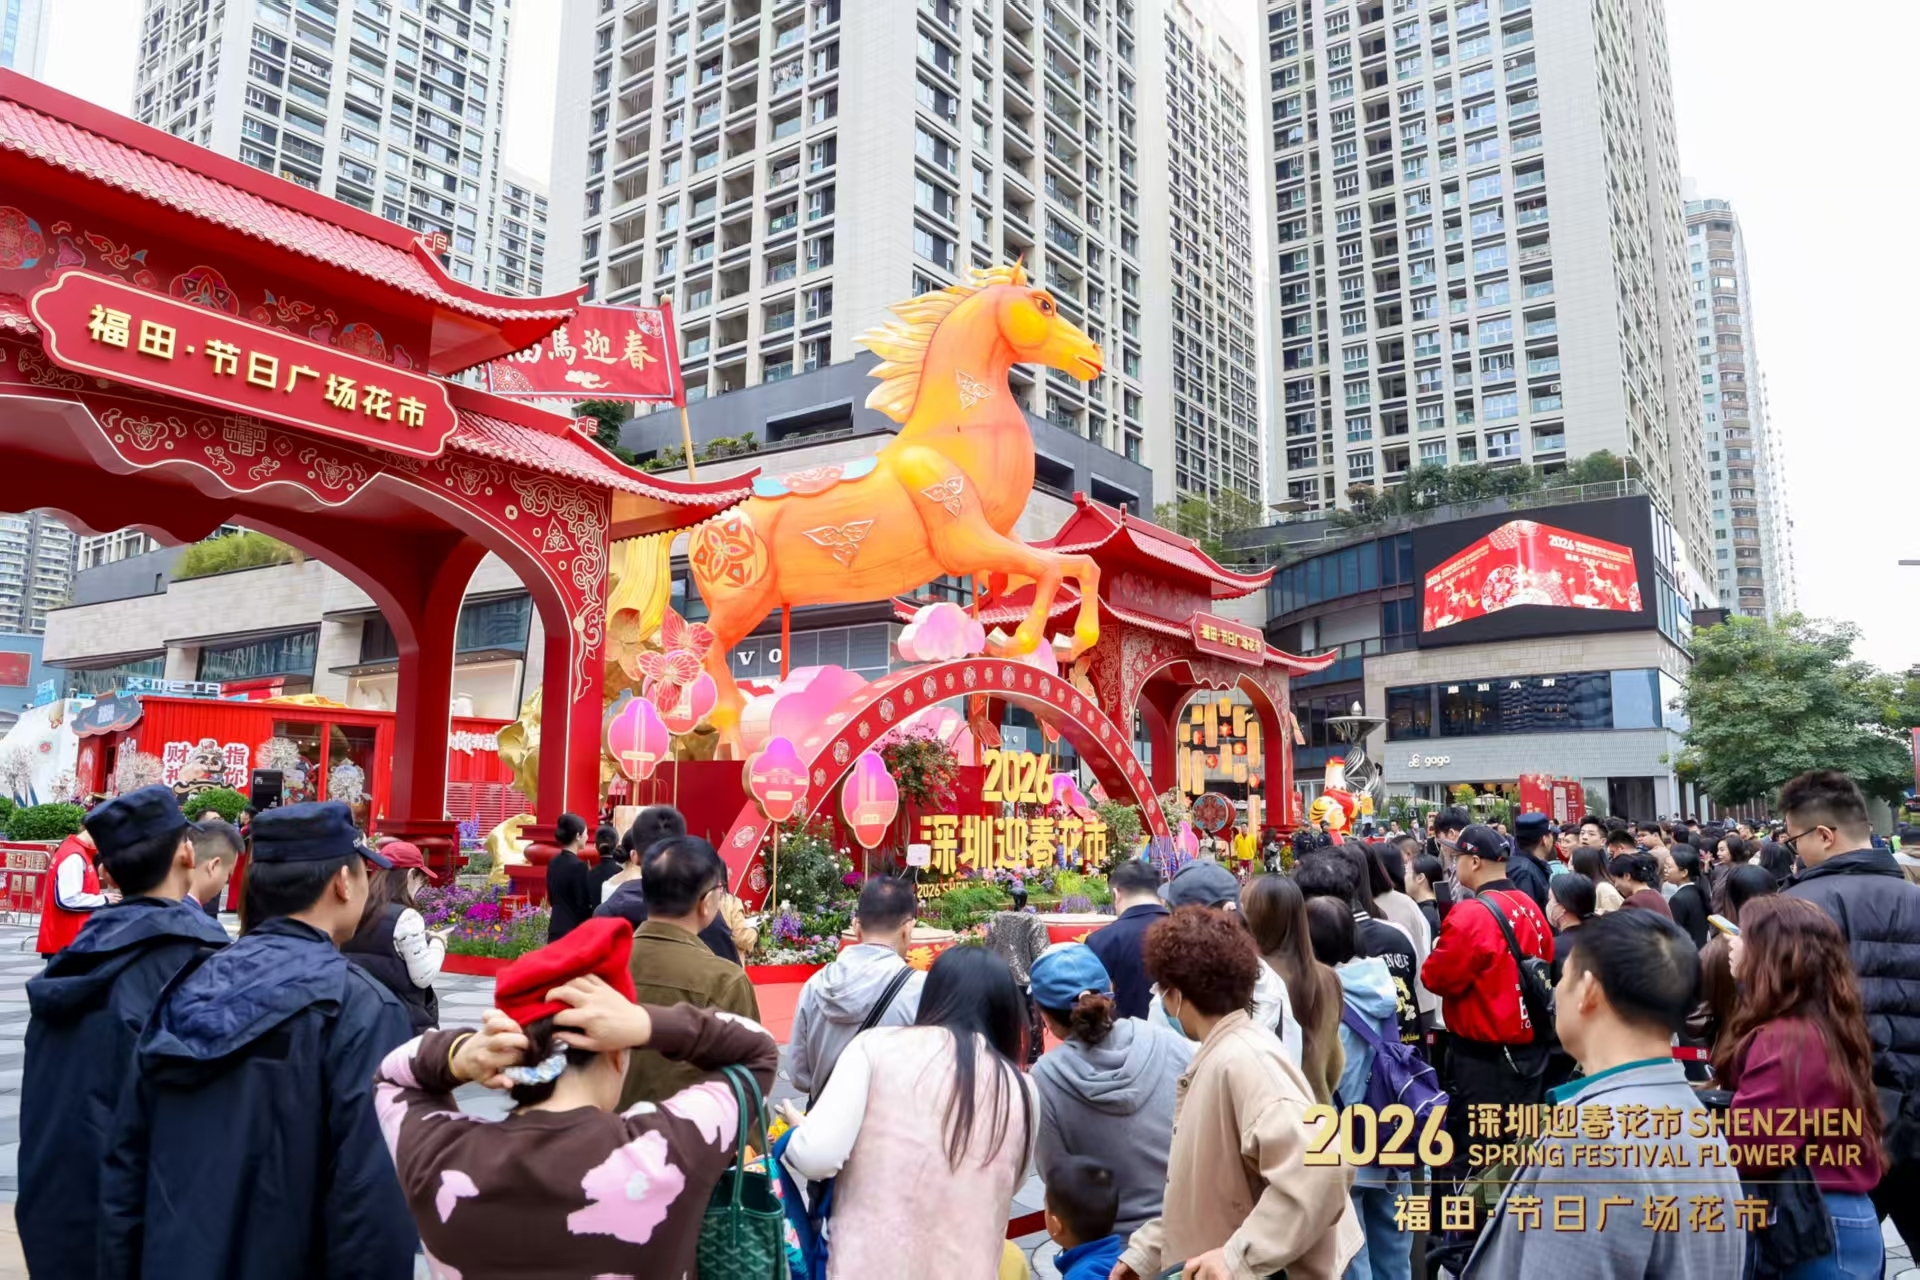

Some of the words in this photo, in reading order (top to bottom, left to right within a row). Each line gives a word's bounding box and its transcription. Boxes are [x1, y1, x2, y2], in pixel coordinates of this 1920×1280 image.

[982, 749, 1054, 804] 2026
[1424, 755, 1450, 767] gogo
[919, 814, 1108, 875] 深圳迎春花市
[917, 884, 941, 898] 2026
